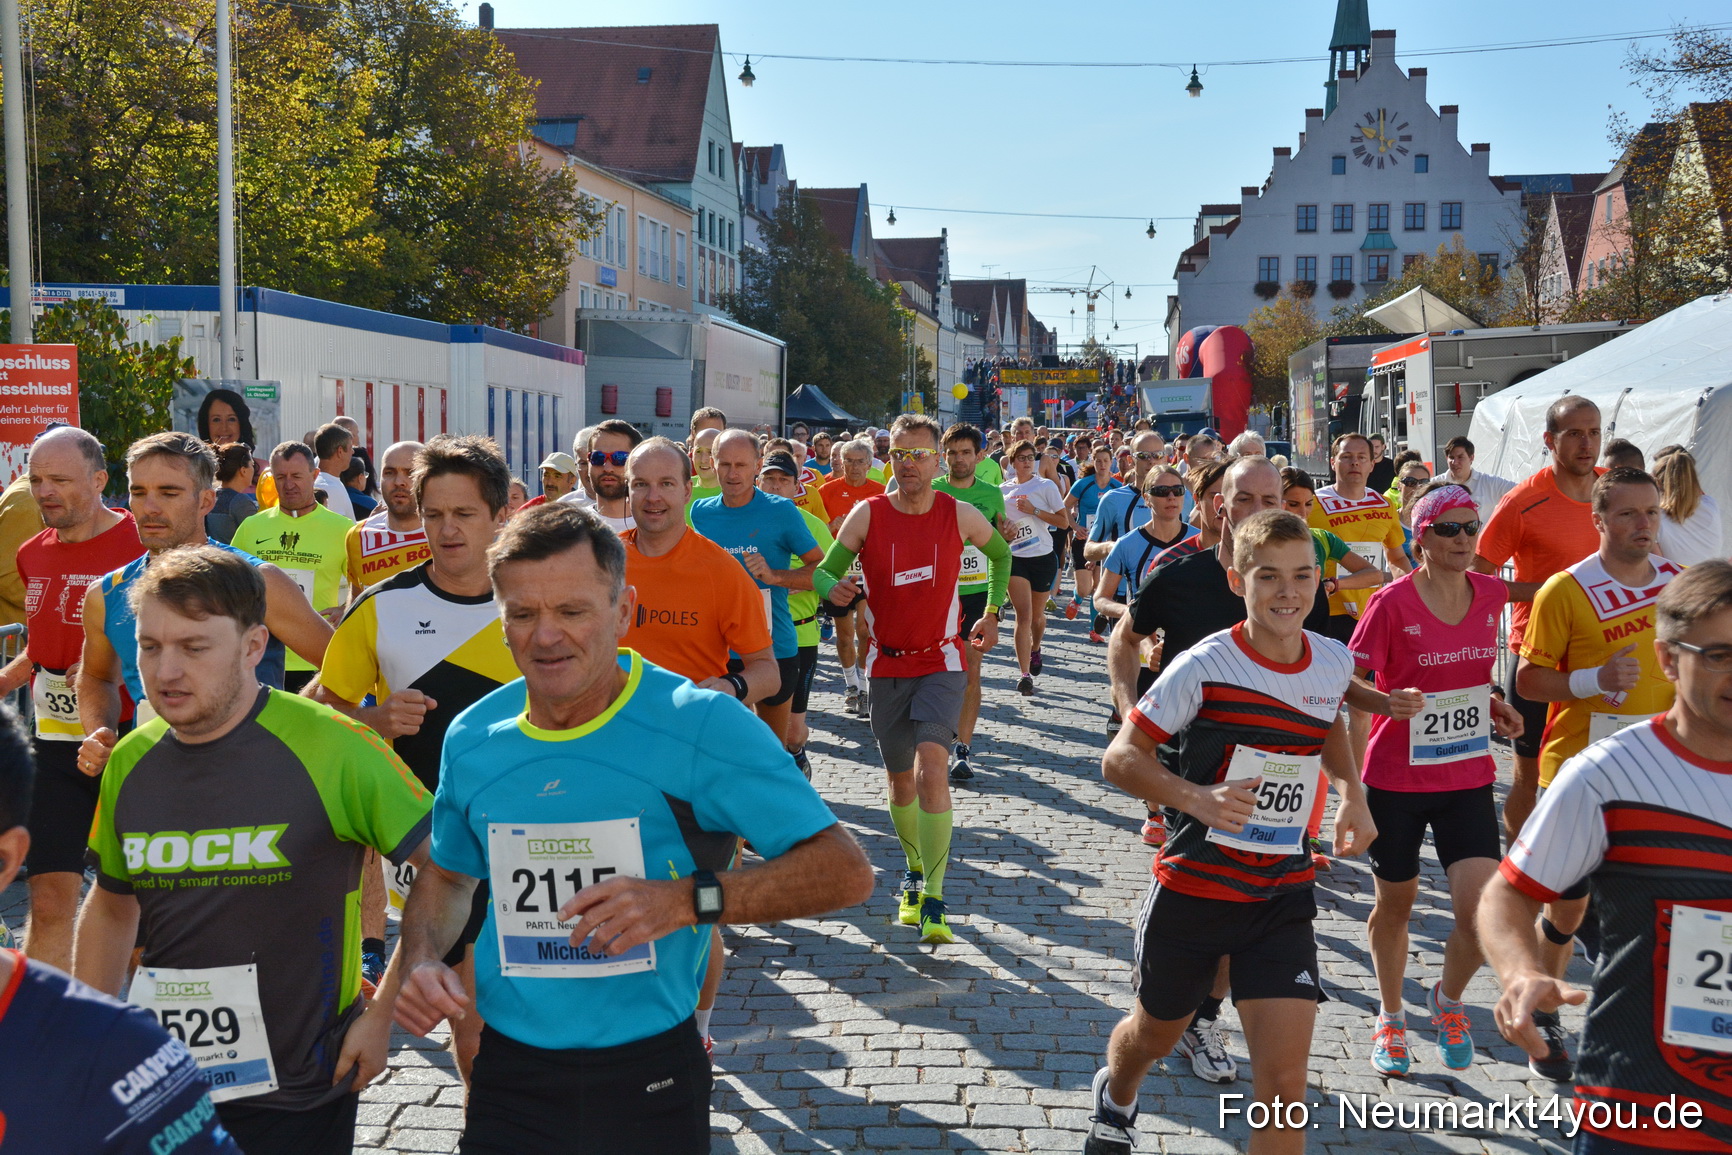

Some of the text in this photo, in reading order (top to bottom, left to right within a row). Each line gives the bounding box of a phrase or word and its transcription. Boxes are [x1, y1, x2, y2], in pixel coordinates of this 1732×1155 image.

[0, 354, 71, 370] schluss
[1032, 372, 1067, 381] START
[0, 382, 72, 396] sschluss!
[24, 405, 54, 414] Lehrer
[57, 404, 70, 414] für
[0, 416, 70, 425] einere Klassen.
[1329, 514, 1361, 527] MAX
[362, 546, 431, 574] MAX BÖ
[905, 572, 923, 580] DEHN
[650, 610, 698, 626] POLES
[1602, 615, 1653, 643] MAX
[1436, 694, 1469, 706] BOCK
[1424, 706, 1479, 734] 2188
[1436, 744, 1469, 756] Gudrun
[1263, 761, 1300, 774] BOCK
[1248, 778, 1304, 812] 566
[1261, 815, 1286, 823] Neumarkt
[1250, 827, 1276, 842] Paul
[122, 827, 286, 871] BOCK
[528, 838, 593, 854] BOCK
[158, 877, 175, 891] by
[179, 875, 219, 888] smart
[223, 870, 292, 886] concepts
[503, 903, 508, 912] B
[526, 921, 555, 930] PARTL
[156, 981, 212, 996] BOCK
